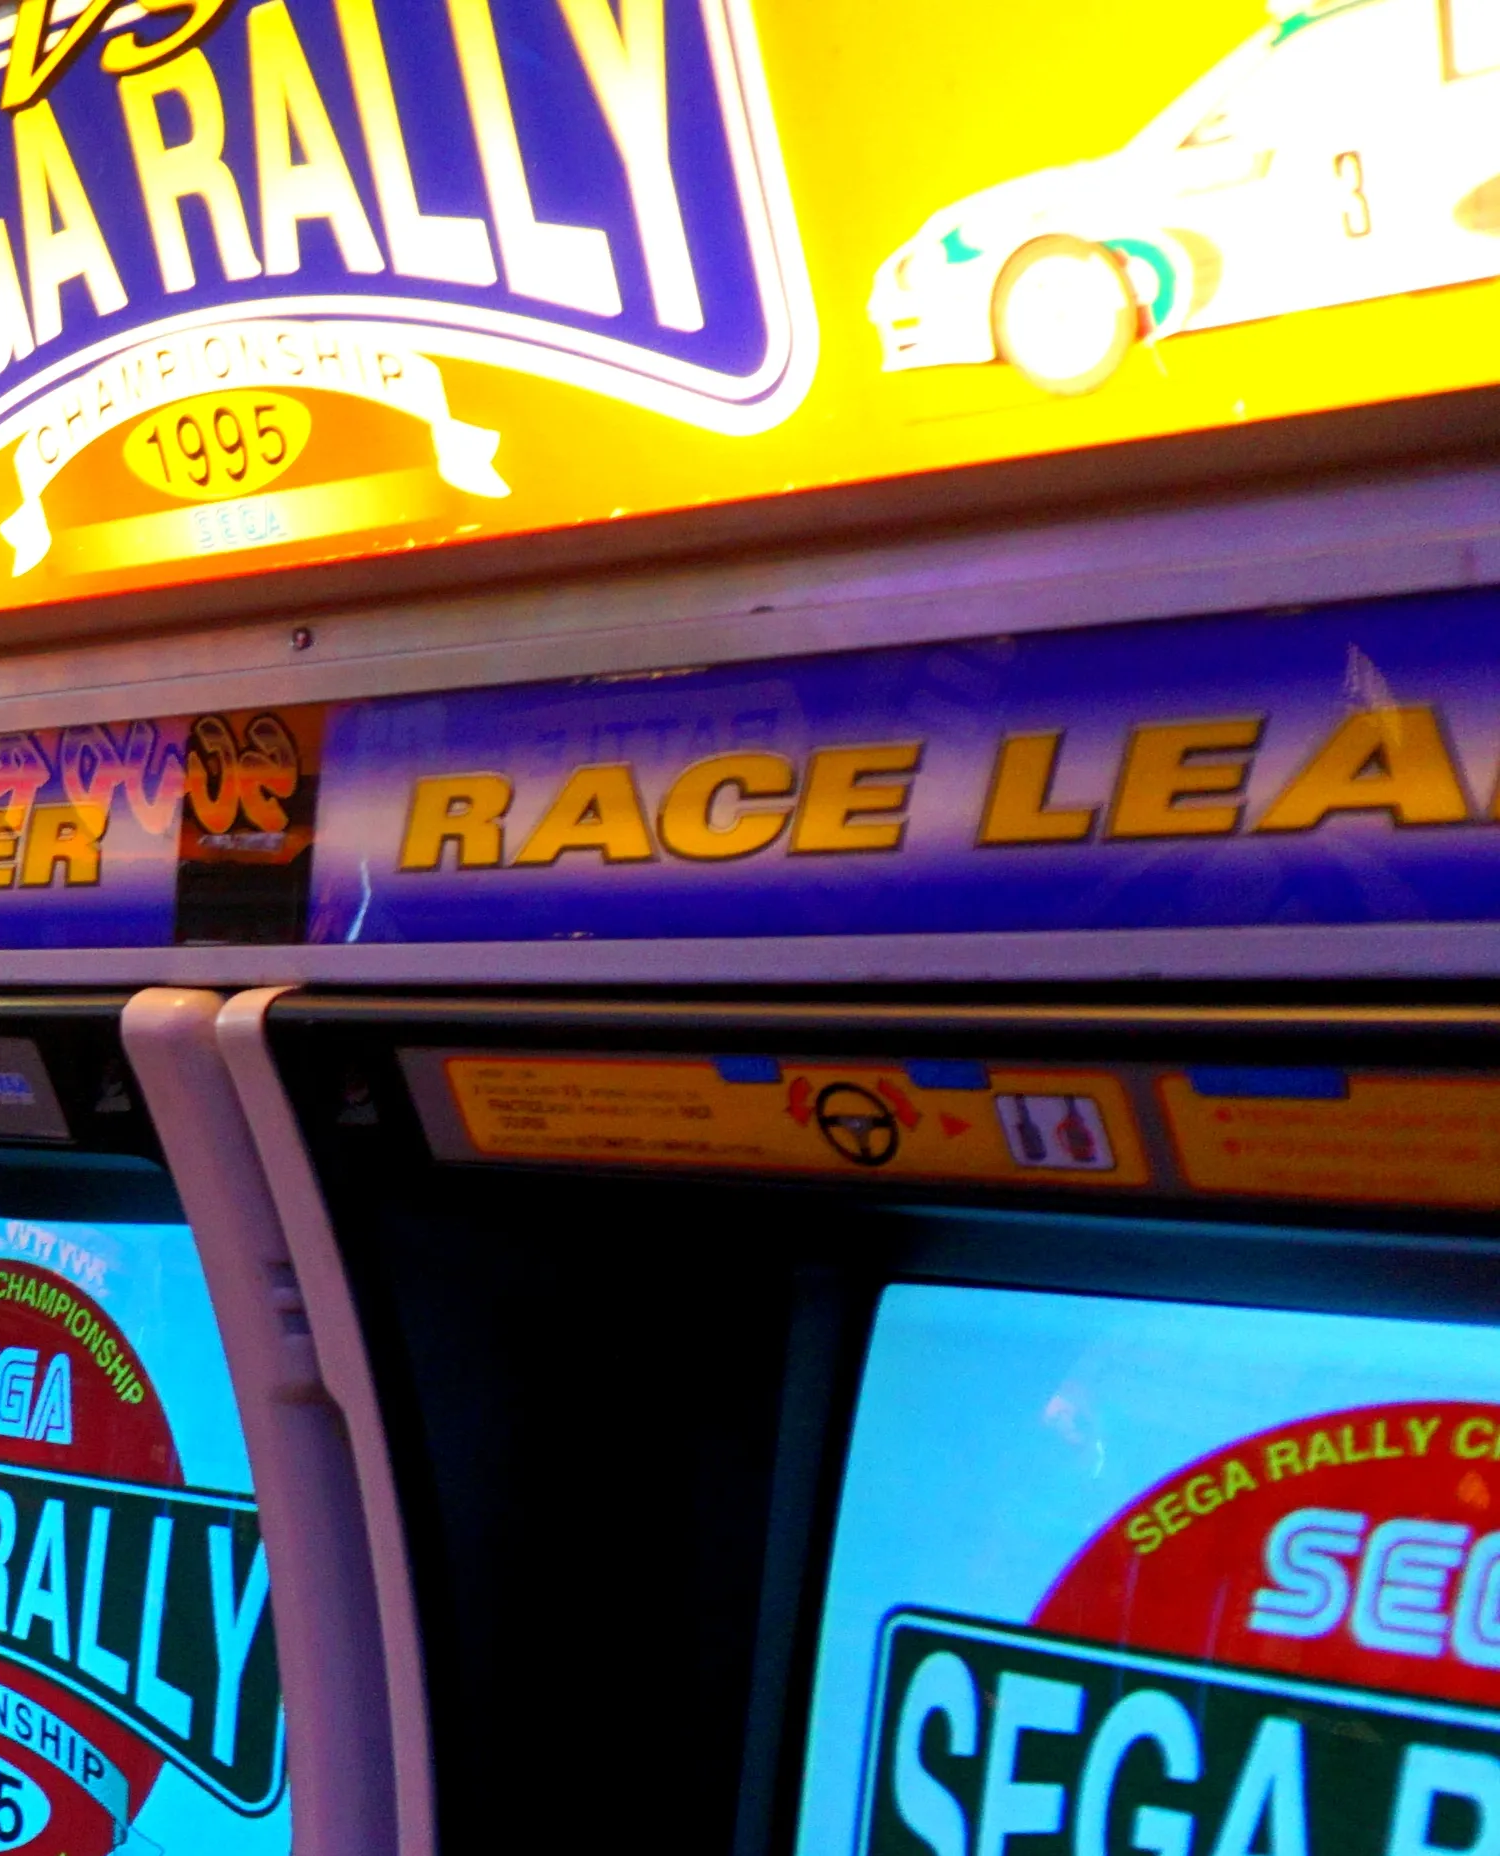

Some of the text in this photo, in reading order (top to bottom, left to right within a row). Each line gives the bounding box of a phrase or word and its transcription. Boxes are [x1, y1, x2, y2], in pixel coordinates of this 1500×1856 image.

[122, 0, 704, 332] RALLY
[1334, 152, 1371, 238] 3
[38, 332, 406, 466] CHAMPIONSHIP
[146, 402, 287, 488] 1995
[398, 740, 922, 873] RACE
[1125, 1460, 1254, 1557] SEGA
[1263, 1416, 1442, 1482] RALLY
